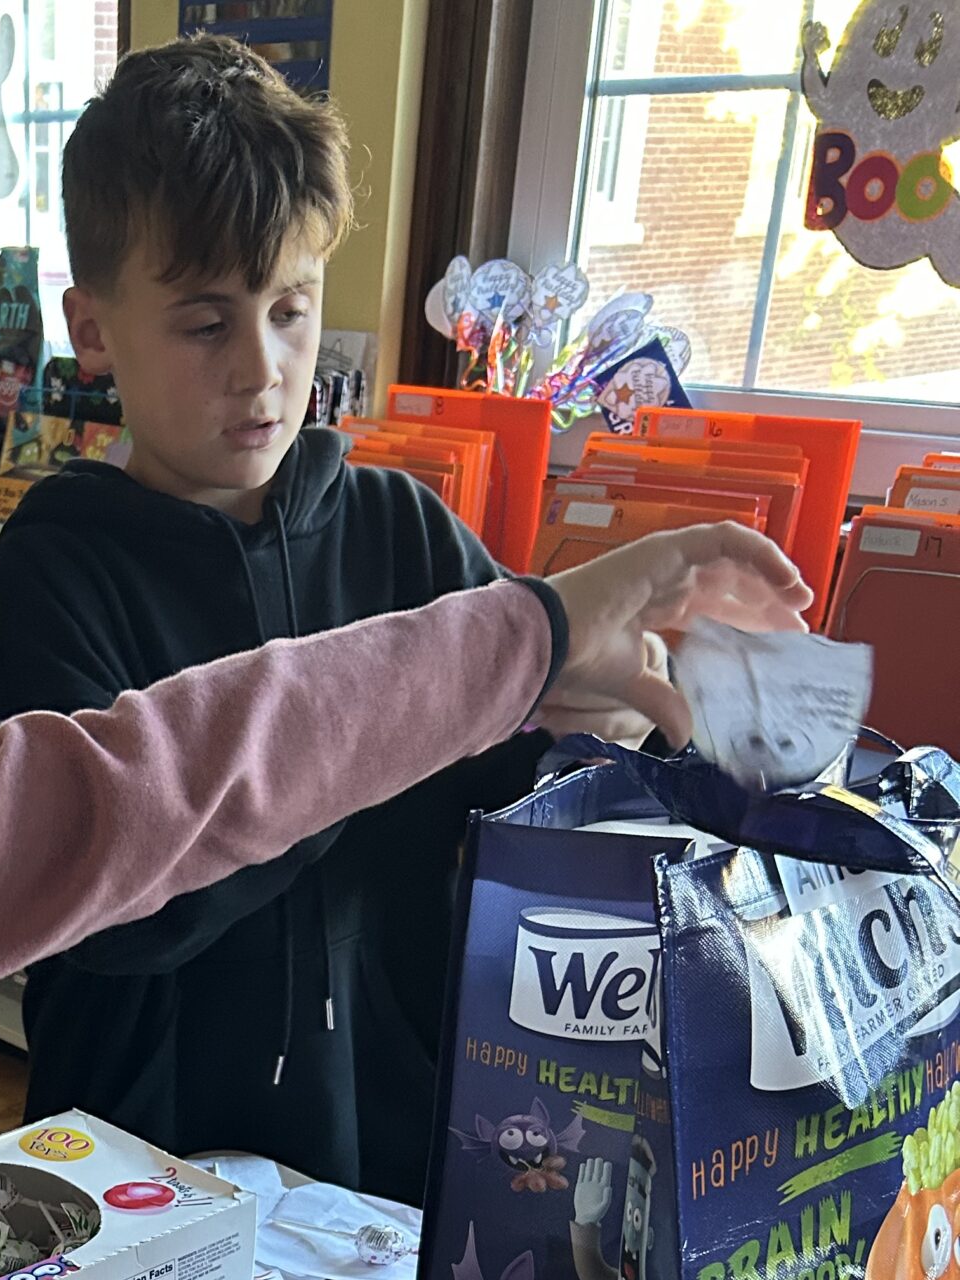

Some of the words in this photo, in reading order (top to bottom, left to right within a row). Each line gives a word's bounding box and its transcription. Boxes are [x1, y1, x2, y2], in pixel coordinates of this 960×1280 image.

[805, 133, 952, 231] BOO
[924, 535, 943, 558] 17
[528, 945, 661, 1022] Wel
[564, 1023, 616, 1036] FAMILY
[465, 1036, 528, 1077] Happy
[35, 1128, 90, 1151] 100
[692, 1128, 779, 1200] Happy
[794, 1060, 925, 1159] HEALTHY
[148, 1166, 178, 1183] 2
[149, 1263, 174, 1280] Facts
